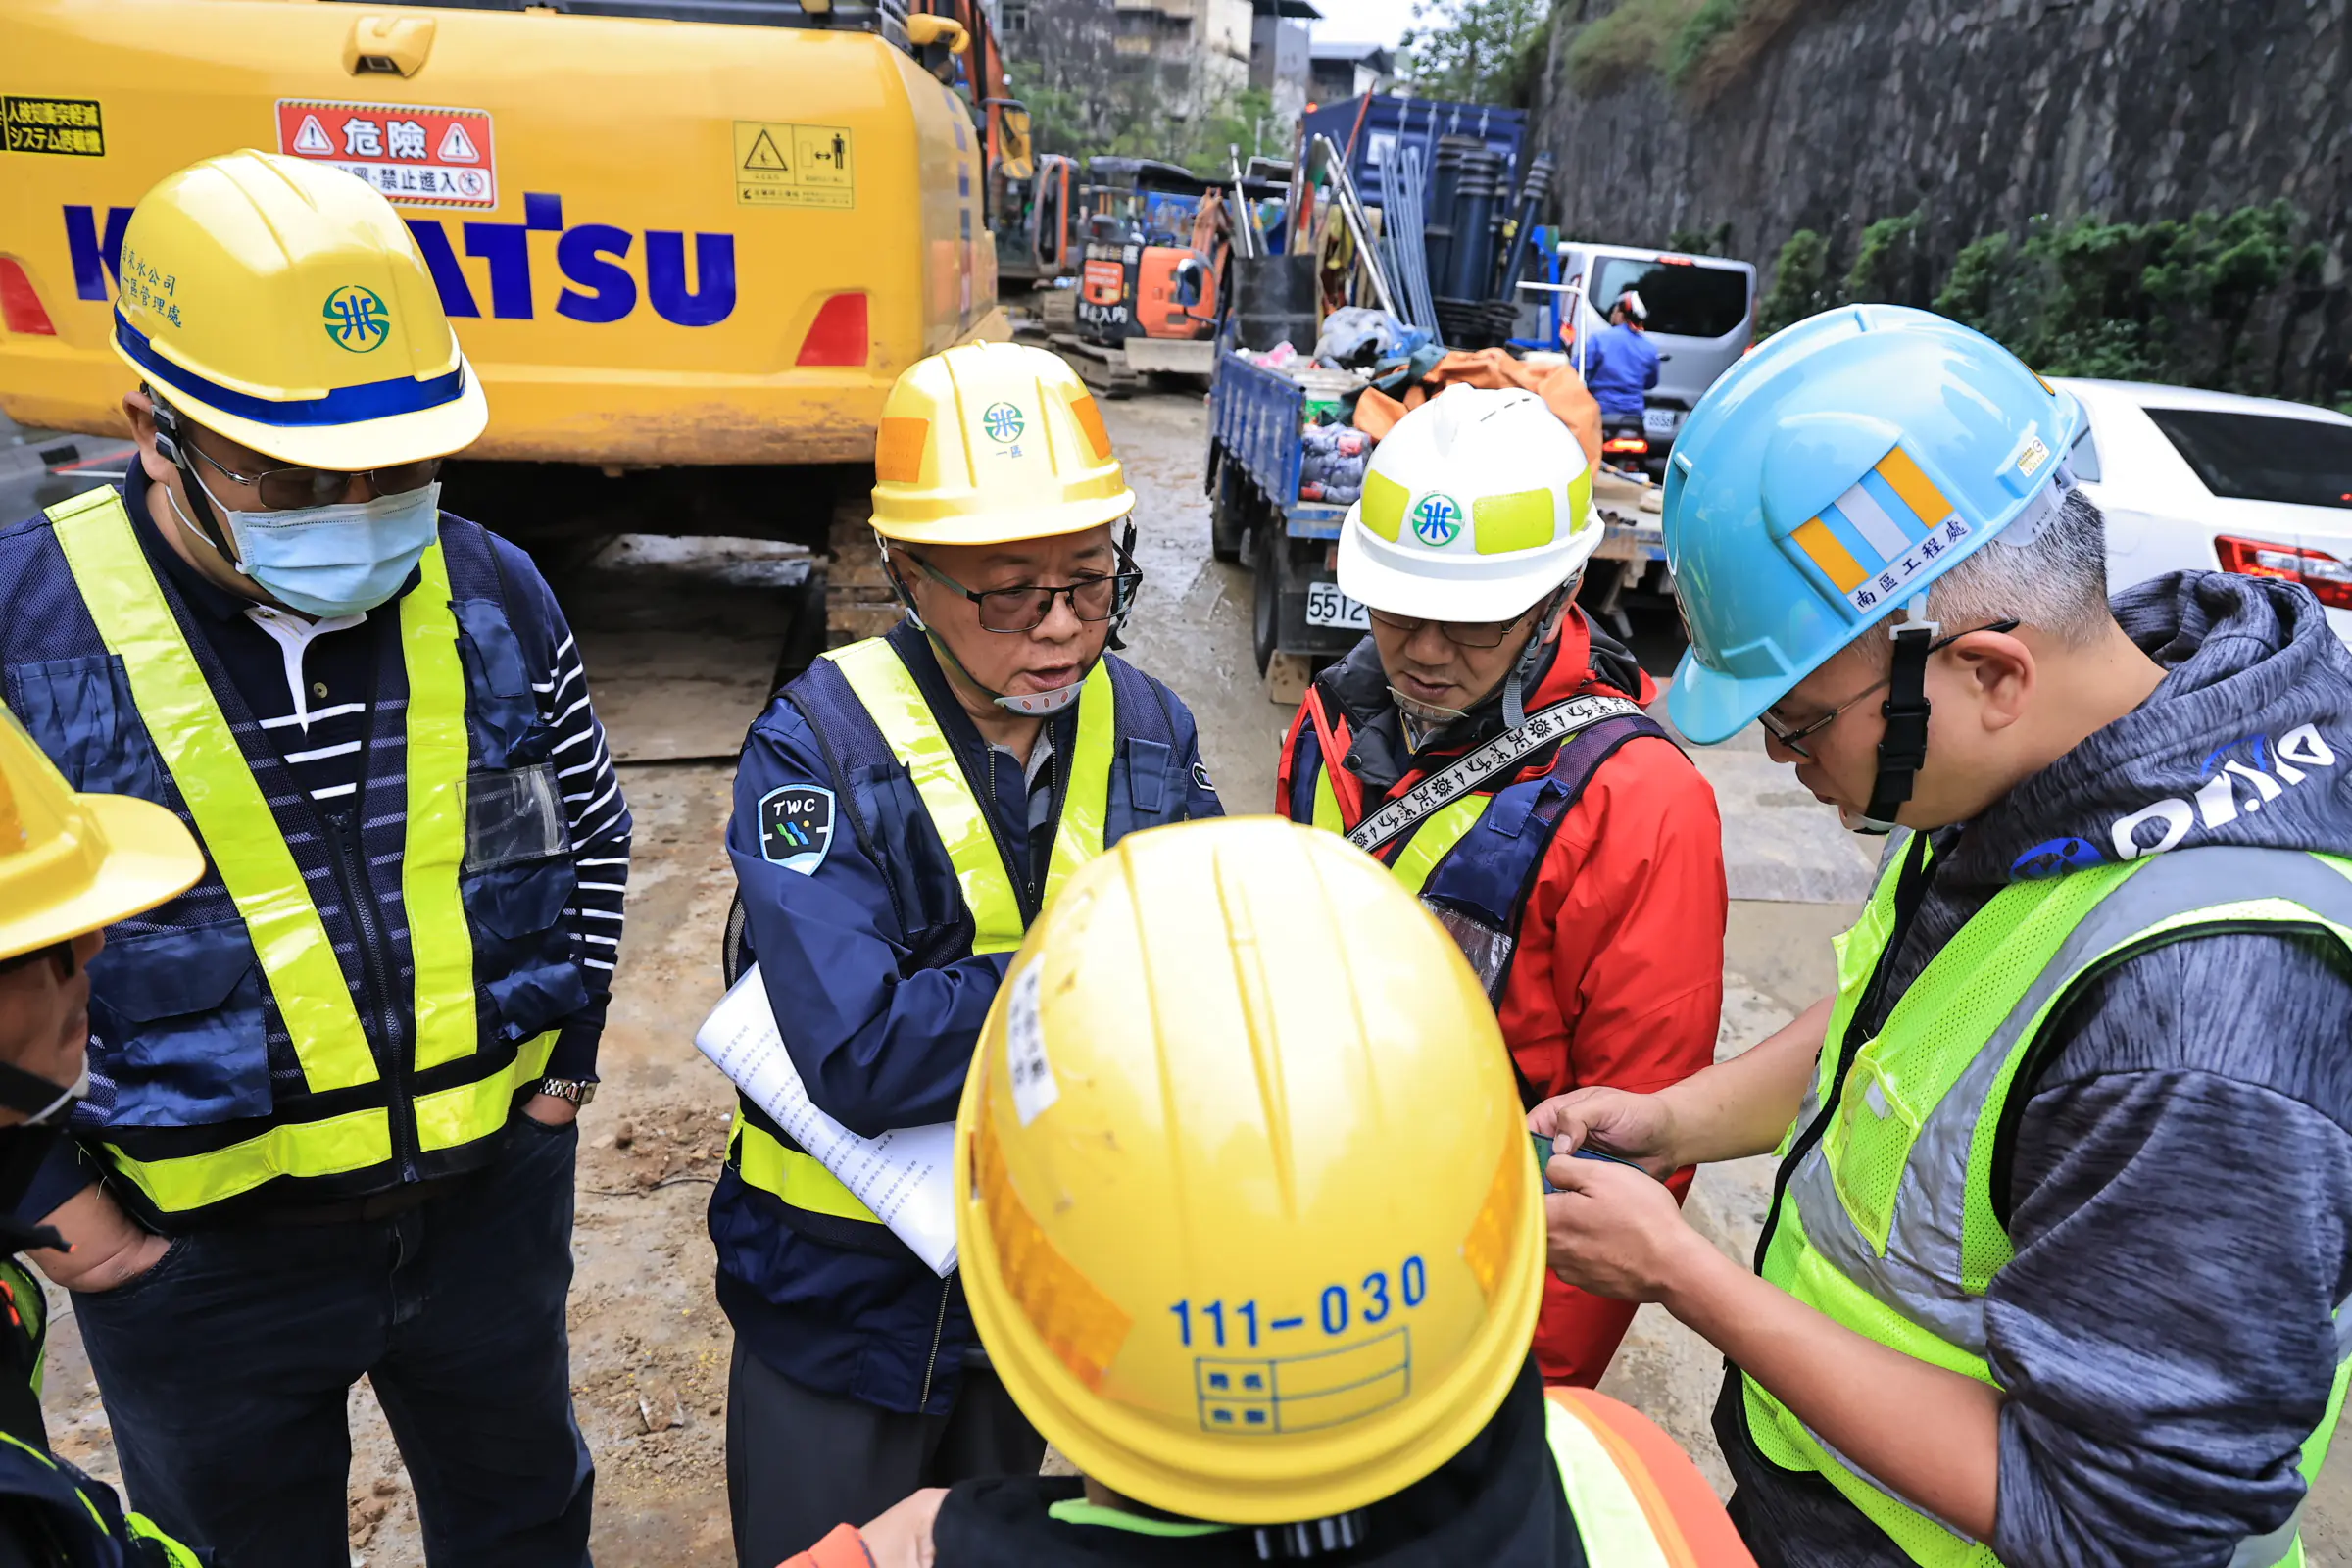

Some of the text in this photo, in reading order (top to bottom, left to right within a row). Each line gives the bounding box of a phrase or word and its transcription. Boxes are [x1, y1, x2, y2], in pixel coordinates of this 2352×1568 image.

[342, 117, 429, 160] 危險
[63, 193, 736, 327] KATSU
[120, 265, 182, 328] 一區管理處
[1856, 519, 1969, 608] 南區工程處
[773, 798, 815, 816] TWC
[1170, 1256, 1425, 1348] 111-030
